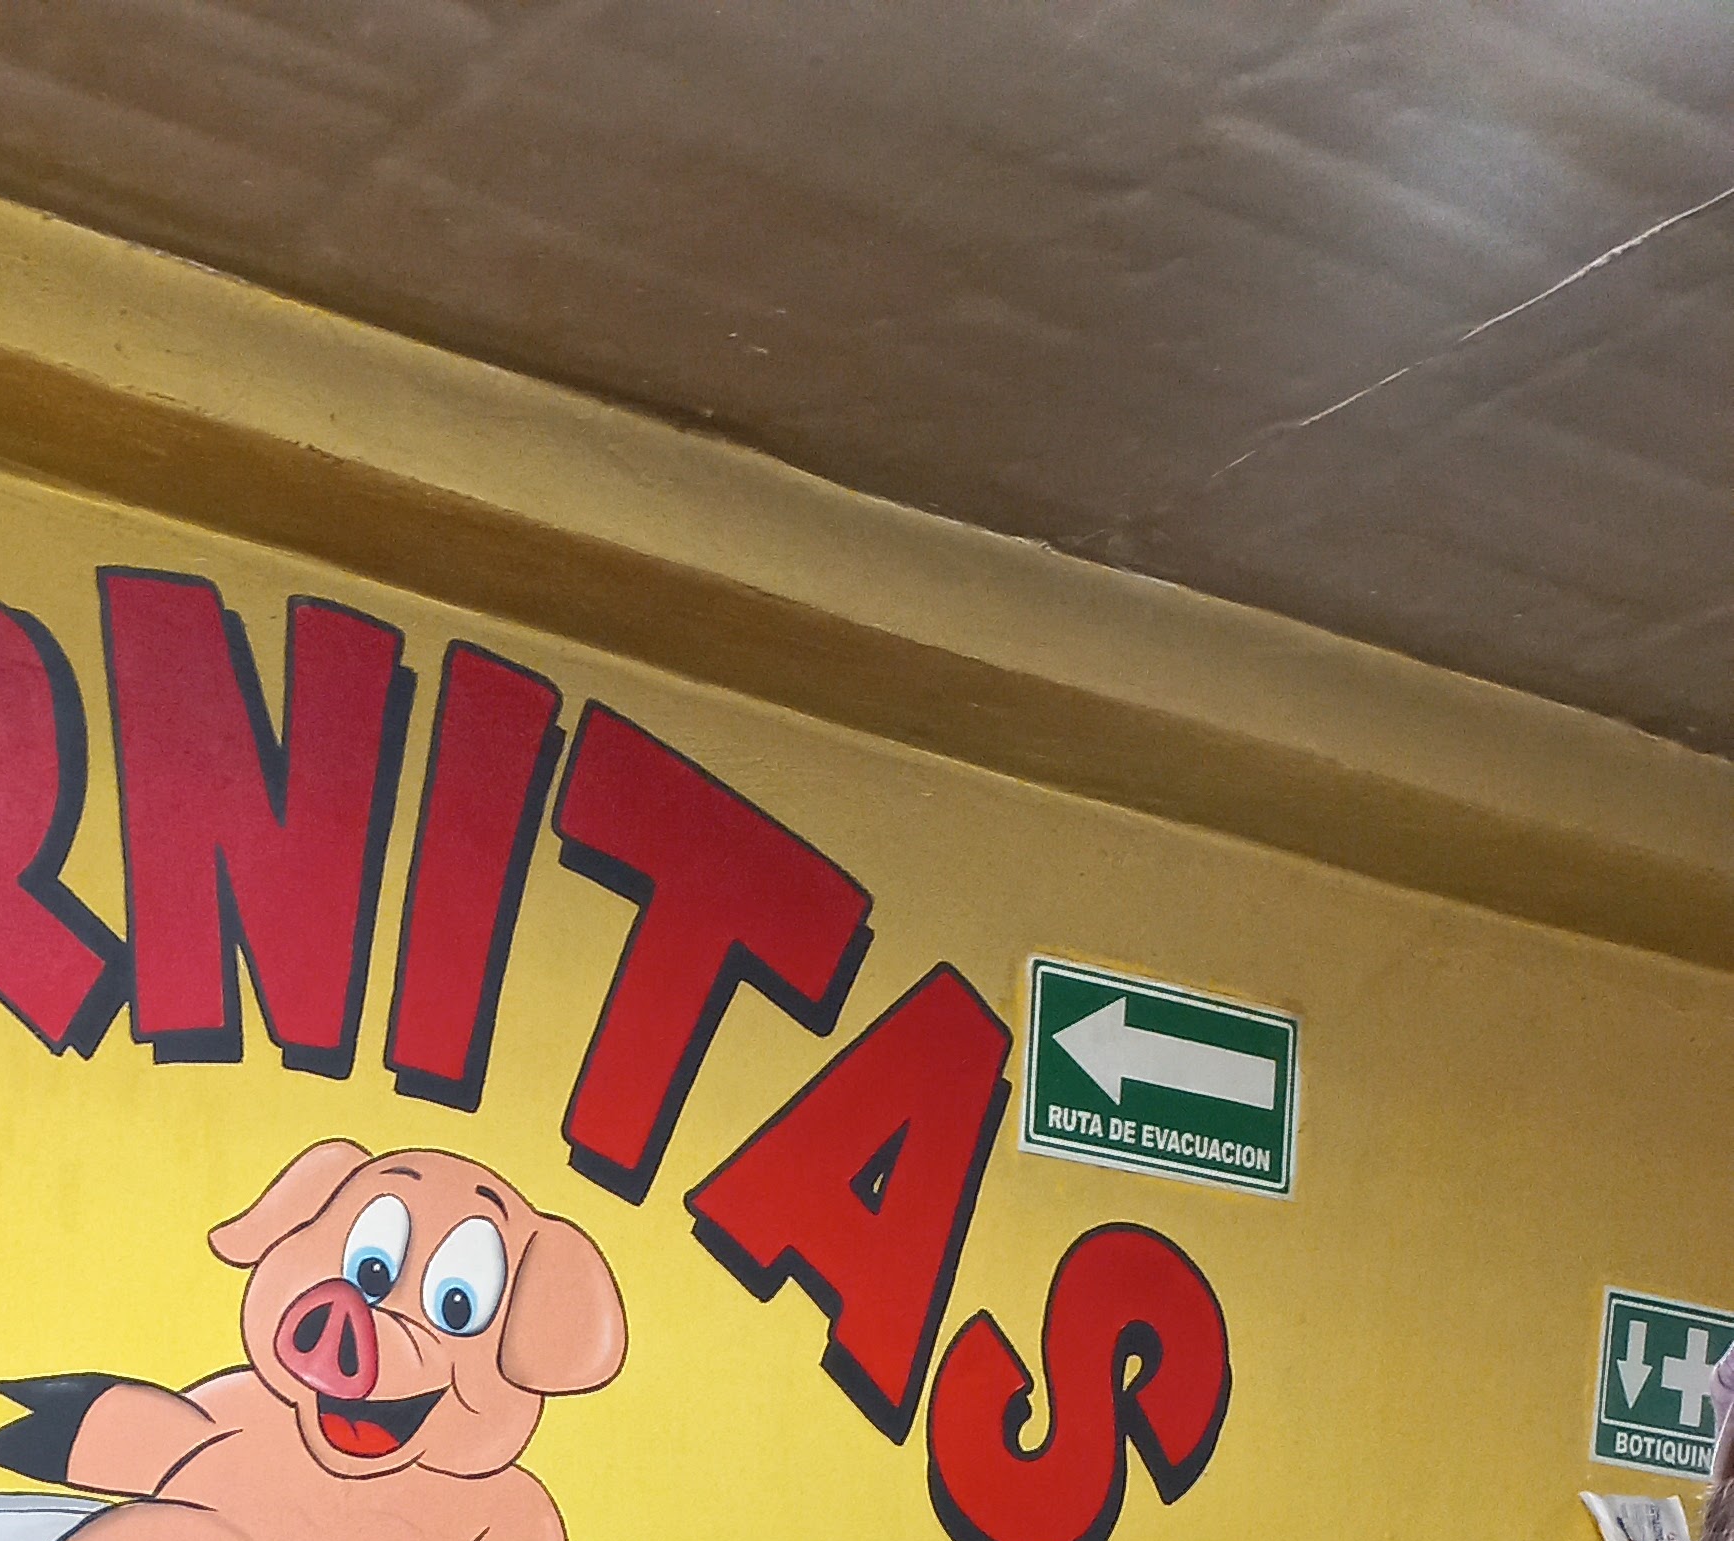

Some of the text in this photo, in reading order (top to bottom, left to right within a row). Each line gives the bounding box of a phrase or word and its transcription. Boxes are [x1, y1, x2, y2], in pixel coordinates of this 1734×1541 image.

[1047, 1104, 1270, 1172] RUTA DE EVACUACION
[1615, 1431, 1712, 1469] BOTIQUIN
